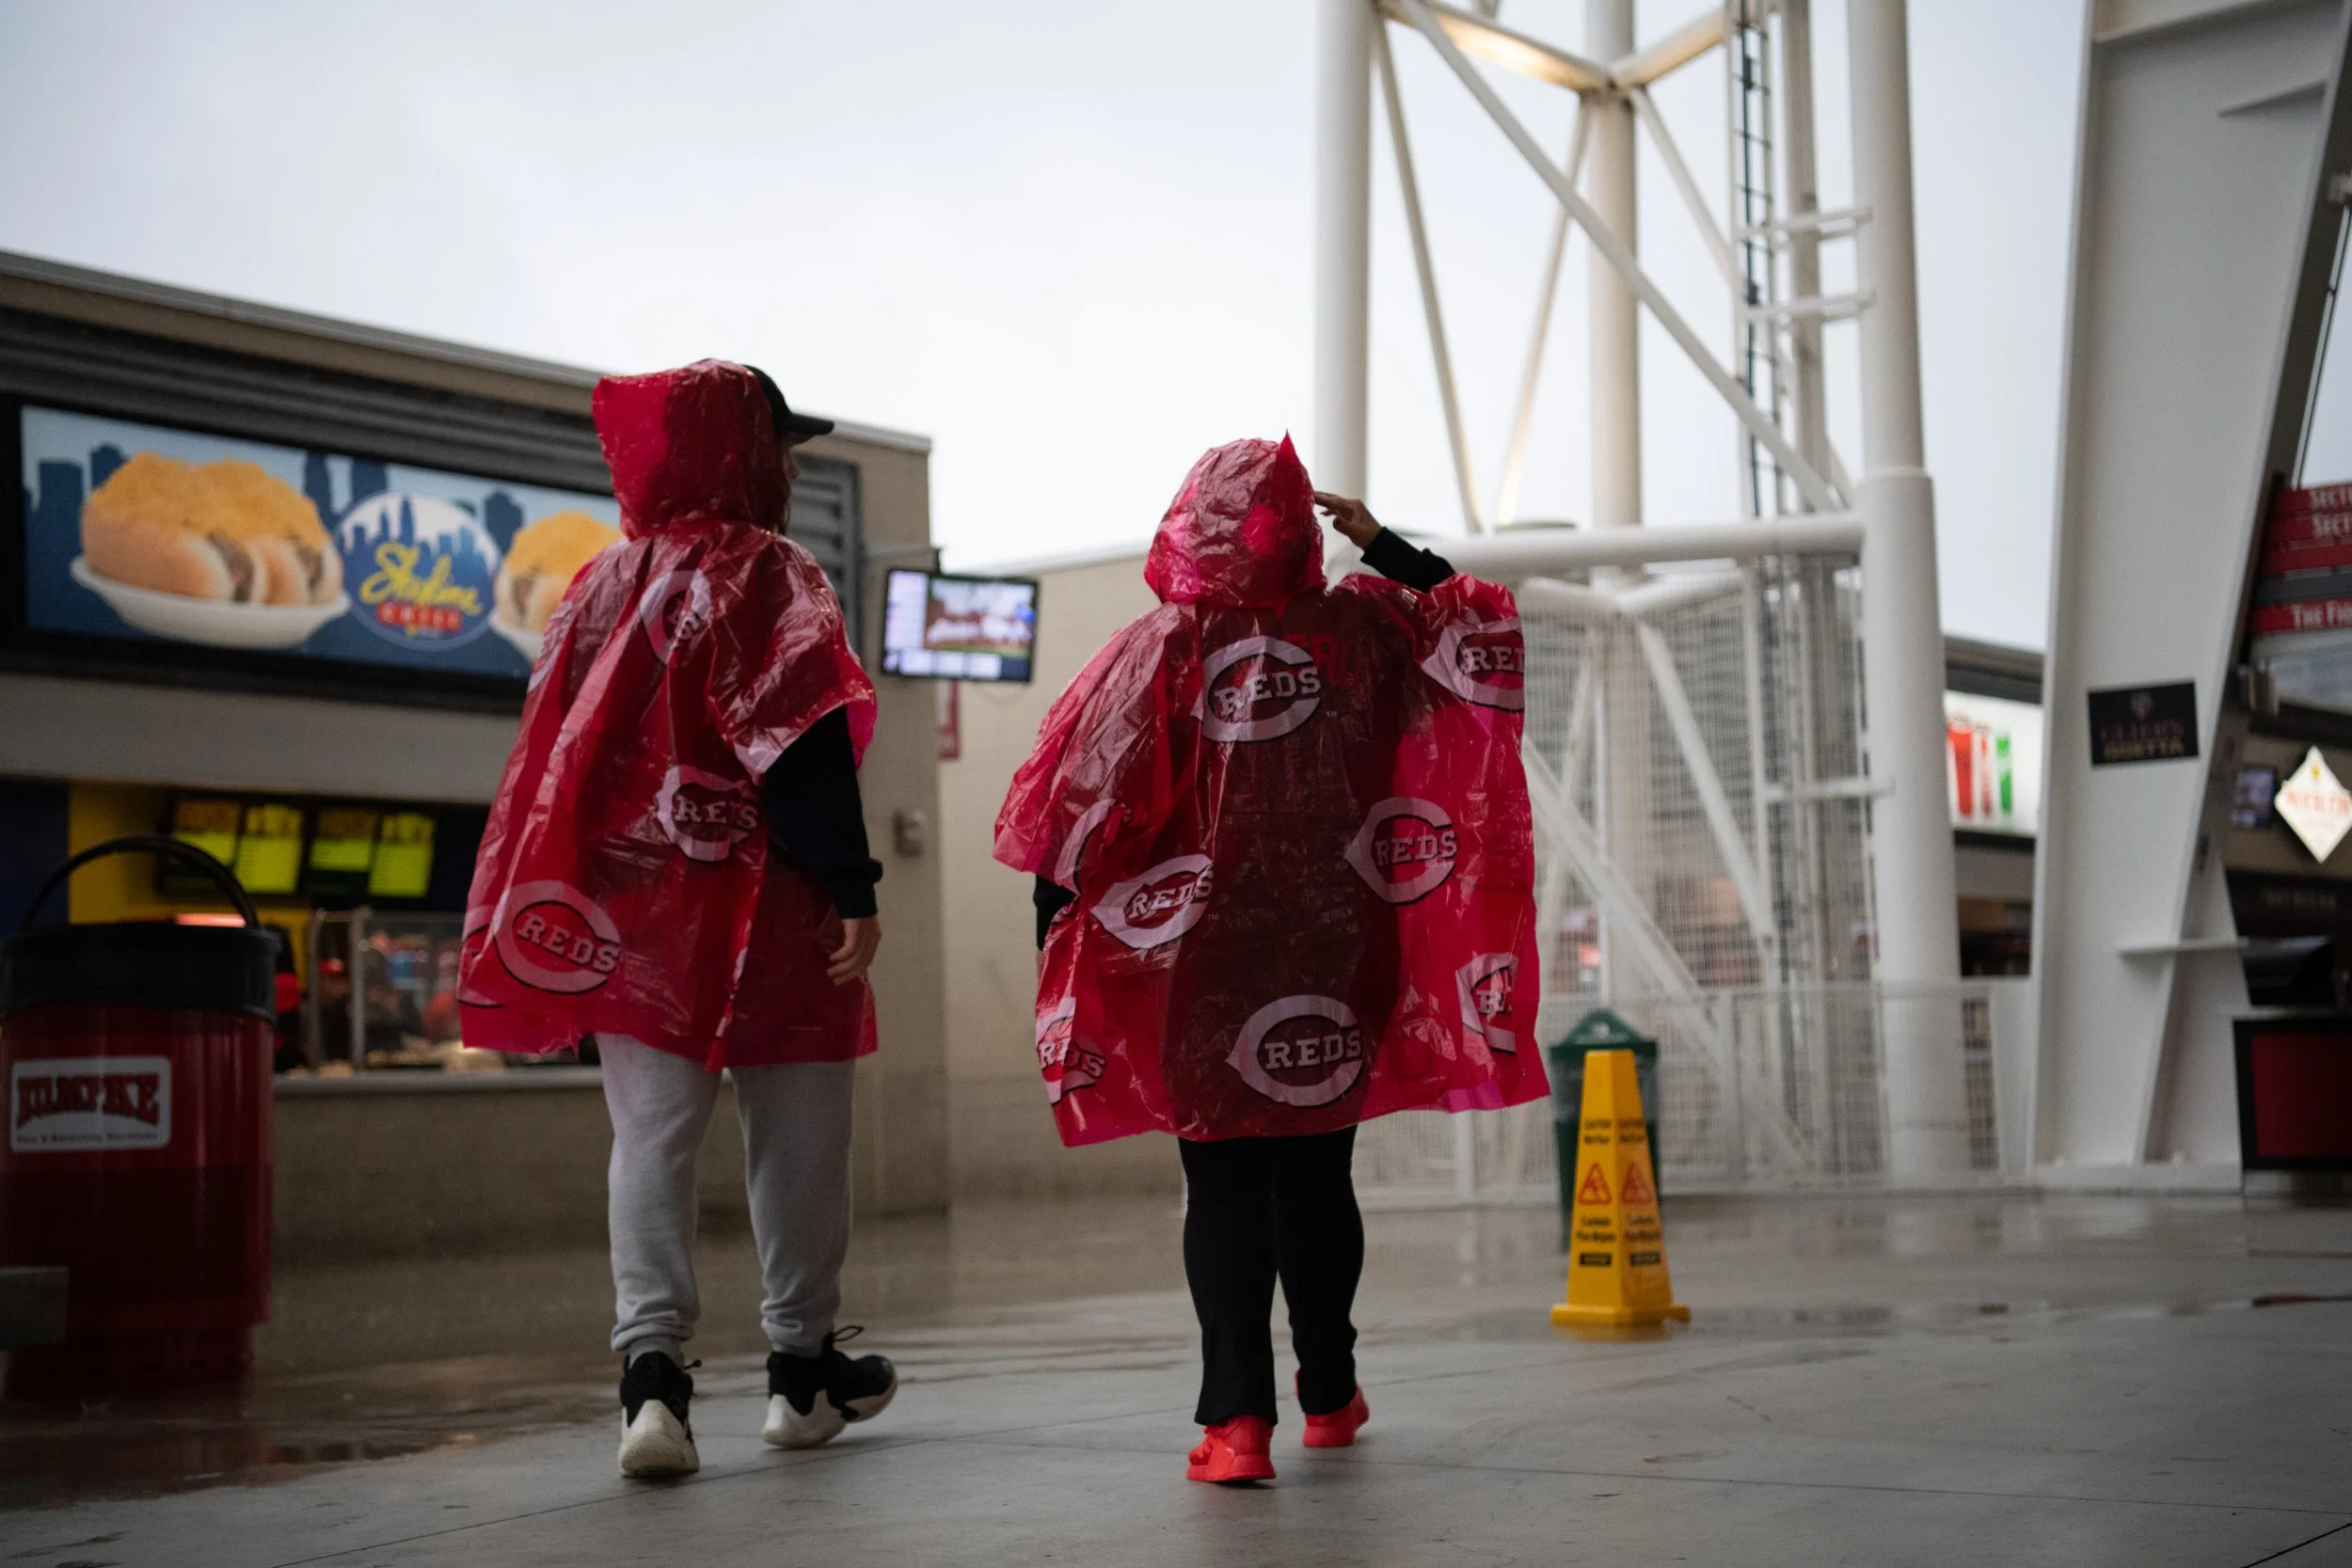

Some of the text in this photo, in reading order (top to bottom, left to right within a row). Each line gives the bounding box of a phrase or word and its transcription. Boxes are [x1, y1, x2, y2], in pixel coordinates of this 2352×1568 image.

[1215, 666, 1321, 717] REDS
[674, 795, 757, 830] RES
[1375, 829, 1457, 866] REDS
[517, 911, 622, 974] REDS
[1264, 1031, 1362, 1069] REDS
